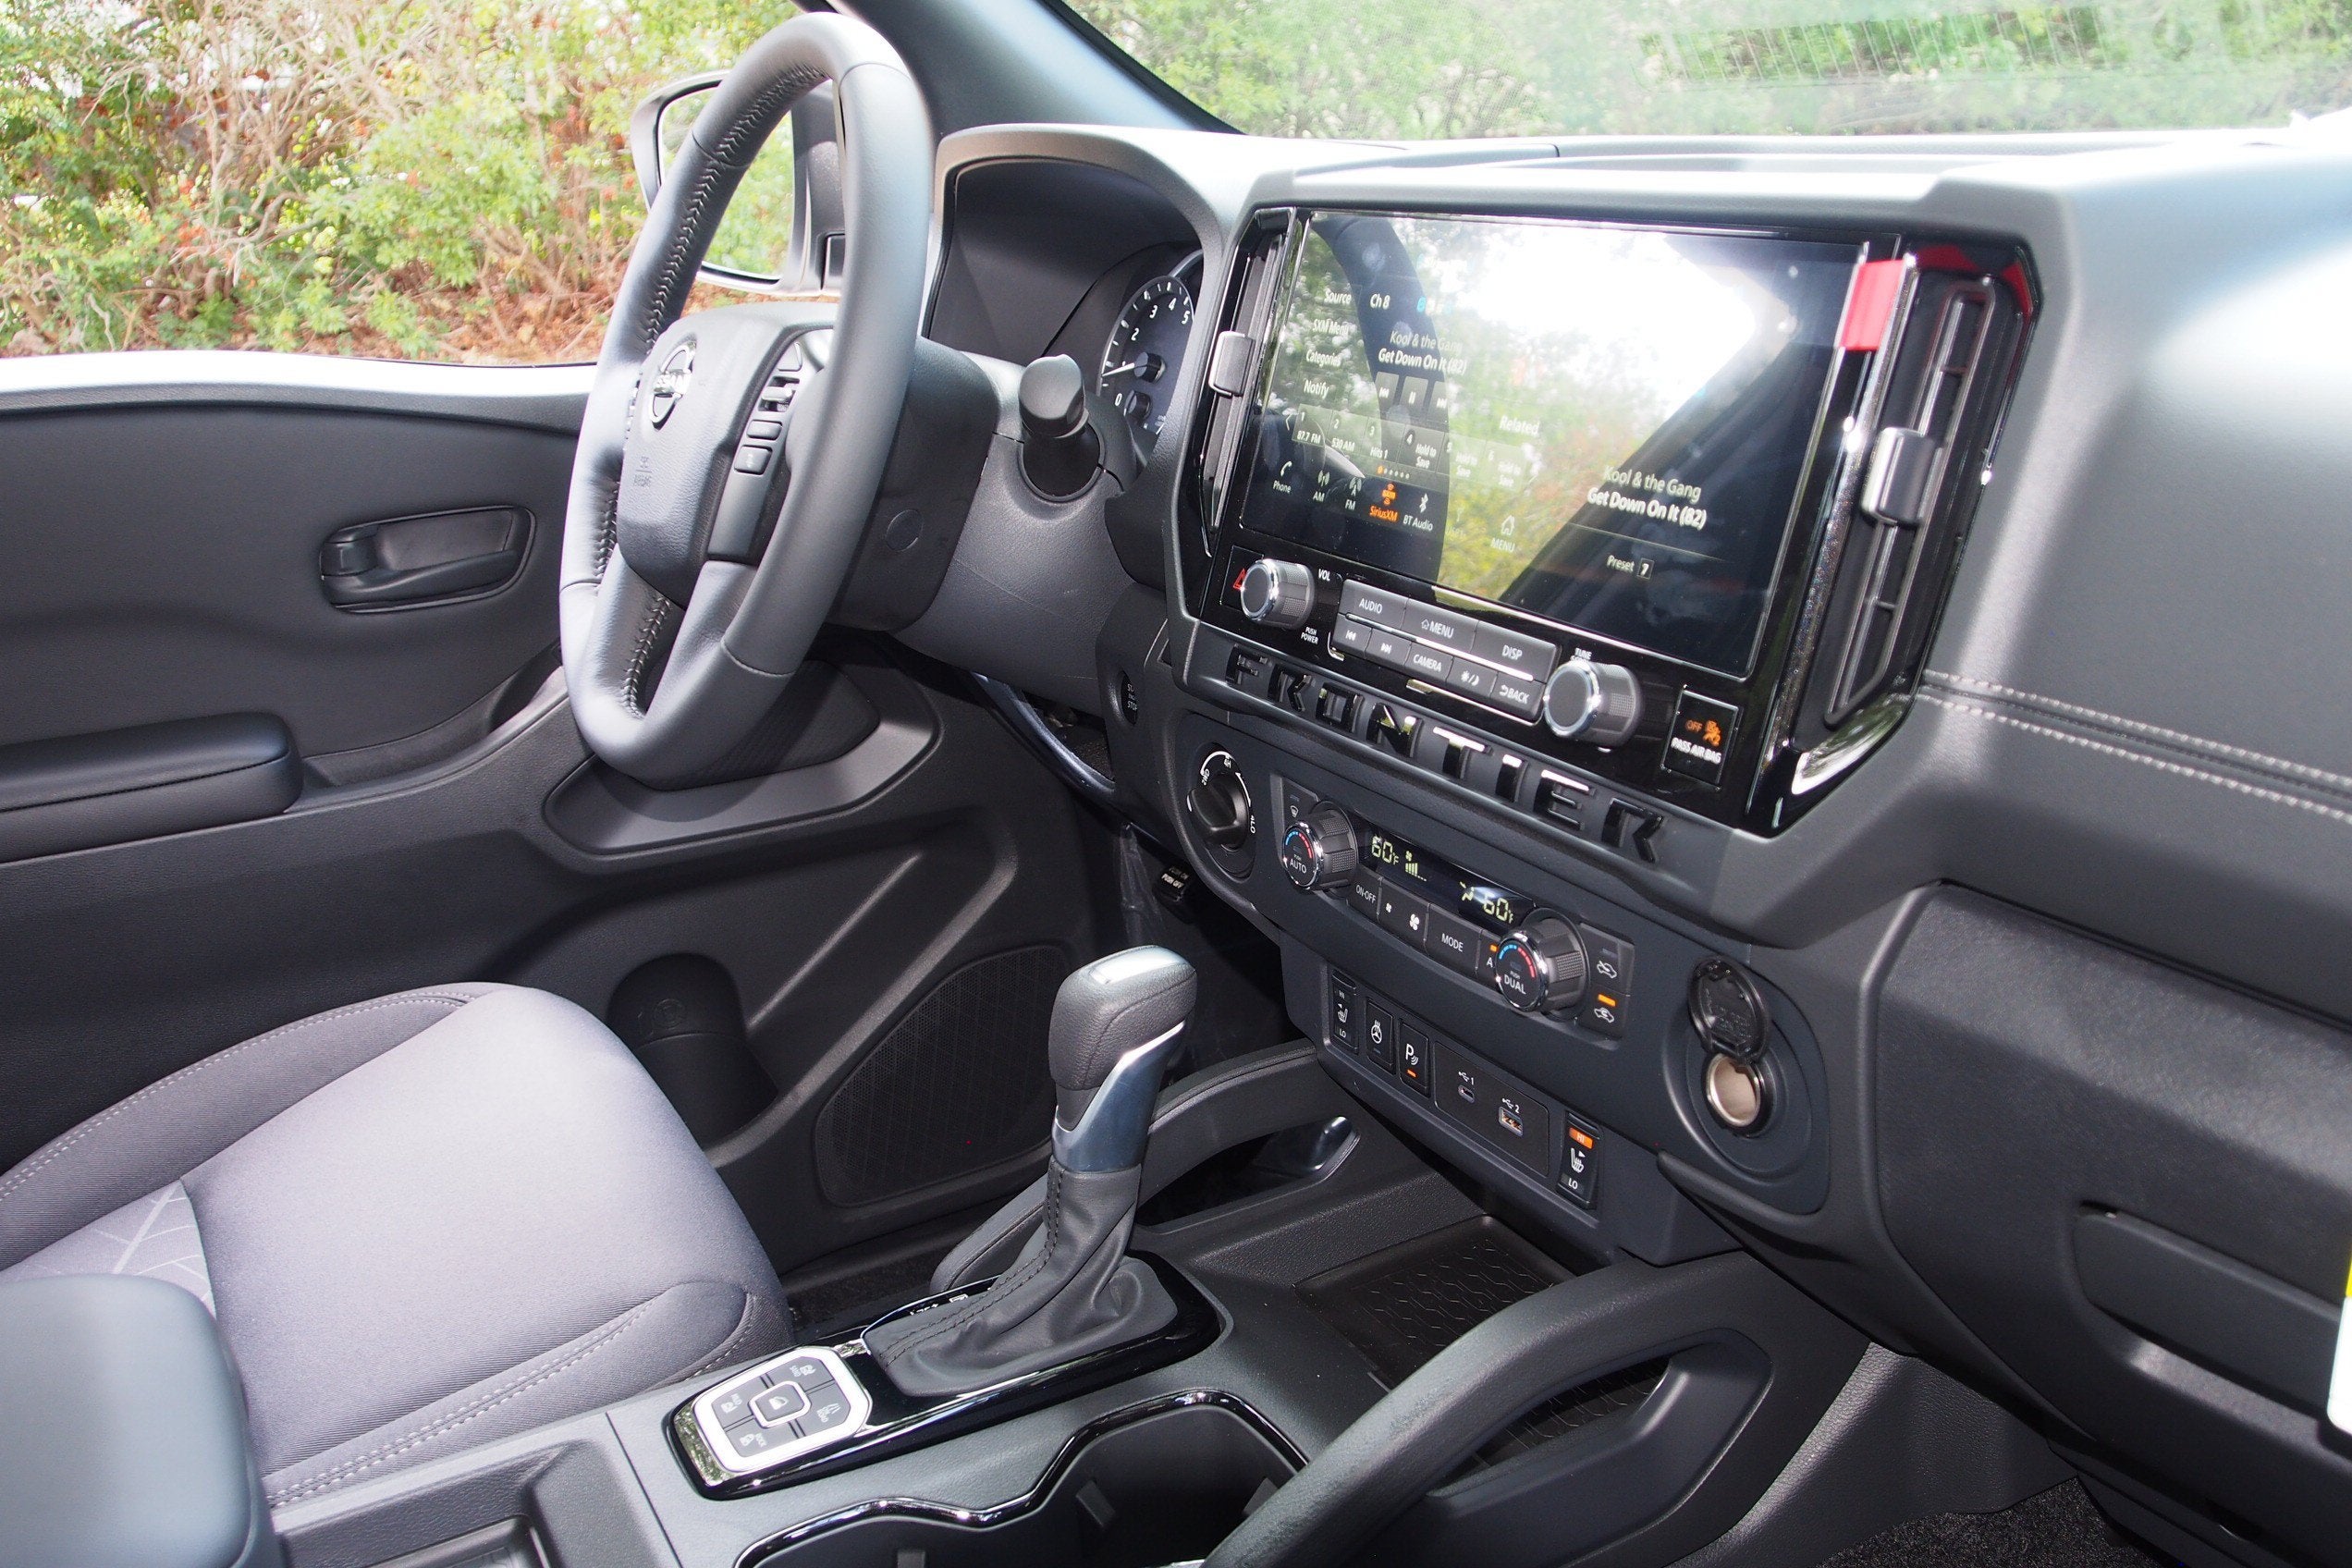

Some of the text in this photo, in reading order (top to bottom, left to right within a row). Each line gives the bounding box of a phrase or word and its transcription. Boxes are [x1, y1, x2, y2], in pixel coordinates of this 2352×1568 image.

[1168, 297, 1177, 311] 4
[1324, 291, 1352, 306] Source
[1369, 293, 1390, 310] Ch 8
[1149, 304, 1158, 319] 3
[1181, 310, 1191, 325] 5
[1313, 319, 1329, 333] SXM
[1131, 327, 1140, 341] 2
[1390, 331, 1411, 346] Kool
[1412, 333, 1419, 348] &
[1420, 334, 1437, 349] the
[1305, 349, 1341, 367] Categories
[1378, 348, 1395, 363] Get
[1394, 349, 1422, 368] Down
[1423, 354, 1439, 370] On
[1438, 357, 1447, 372] It
[1304, 379, 1329, 399] Notify
[1114, 392, 1123, 407] 0
[1301, 411, 1305, 422] 1
[1333, 419, 1340, 429] 2
[1369, 426, 1375, 436] 3
[1499, 415, 1540, 437] Related
[1310, 433, 1321, 444] FM
[1342, 440, 1355, 452] AM
[1406, 434, 1413, 446] 4
[1272, 480, 1292, 494] Phone
[1603, 465, 1702, 504] Kool & the Gang
[1312, 491, 1325, 502] AM
[1345, 499, 1356, 510] FM
[1586, 487, 1707, 531] Get Down On It (82)
[1369, 505, 1399, 522] SiriusXM
[1403, 514, 1413, 526] BT
[1412, 516, 1434, 532] Audio
[1490, 537, 1516, 553] MENU
[1607, 555, 1635, 573] Preset
[1318, 569, 1330, 582] VOL
[1358, 598, 1383, 614] AUDIO
[1305, 627, 1317, 636] PUSH
[1430, 621, 1454, 639] MENU
[1300, 631, 1319, 645] POWER
[1501, 644, 1523, 661] DISP
[1413, 654, 1442, 673] CAMERA
[1507, 689, 1530, 704] BACK
[1685, 719, 1703, 733] OFF
[1671, 737, 1692, 753] PASS
[1225, 645, 1666, 864] FRONTIER
[1290, 858, 1307, 874] AUTO
[1355, 884, 1377, 904] ON-OFF
[1441, 933, 1464, 952] MODE
[1504, 974, 1526, 995] DUAL
[1339, 990, 1345, 999] HI
[1339, 1028, 1347, 1038] LO
[1514, 1104, 1520, 1114] 2
[1568, 1177, 1578, 1190] LO
